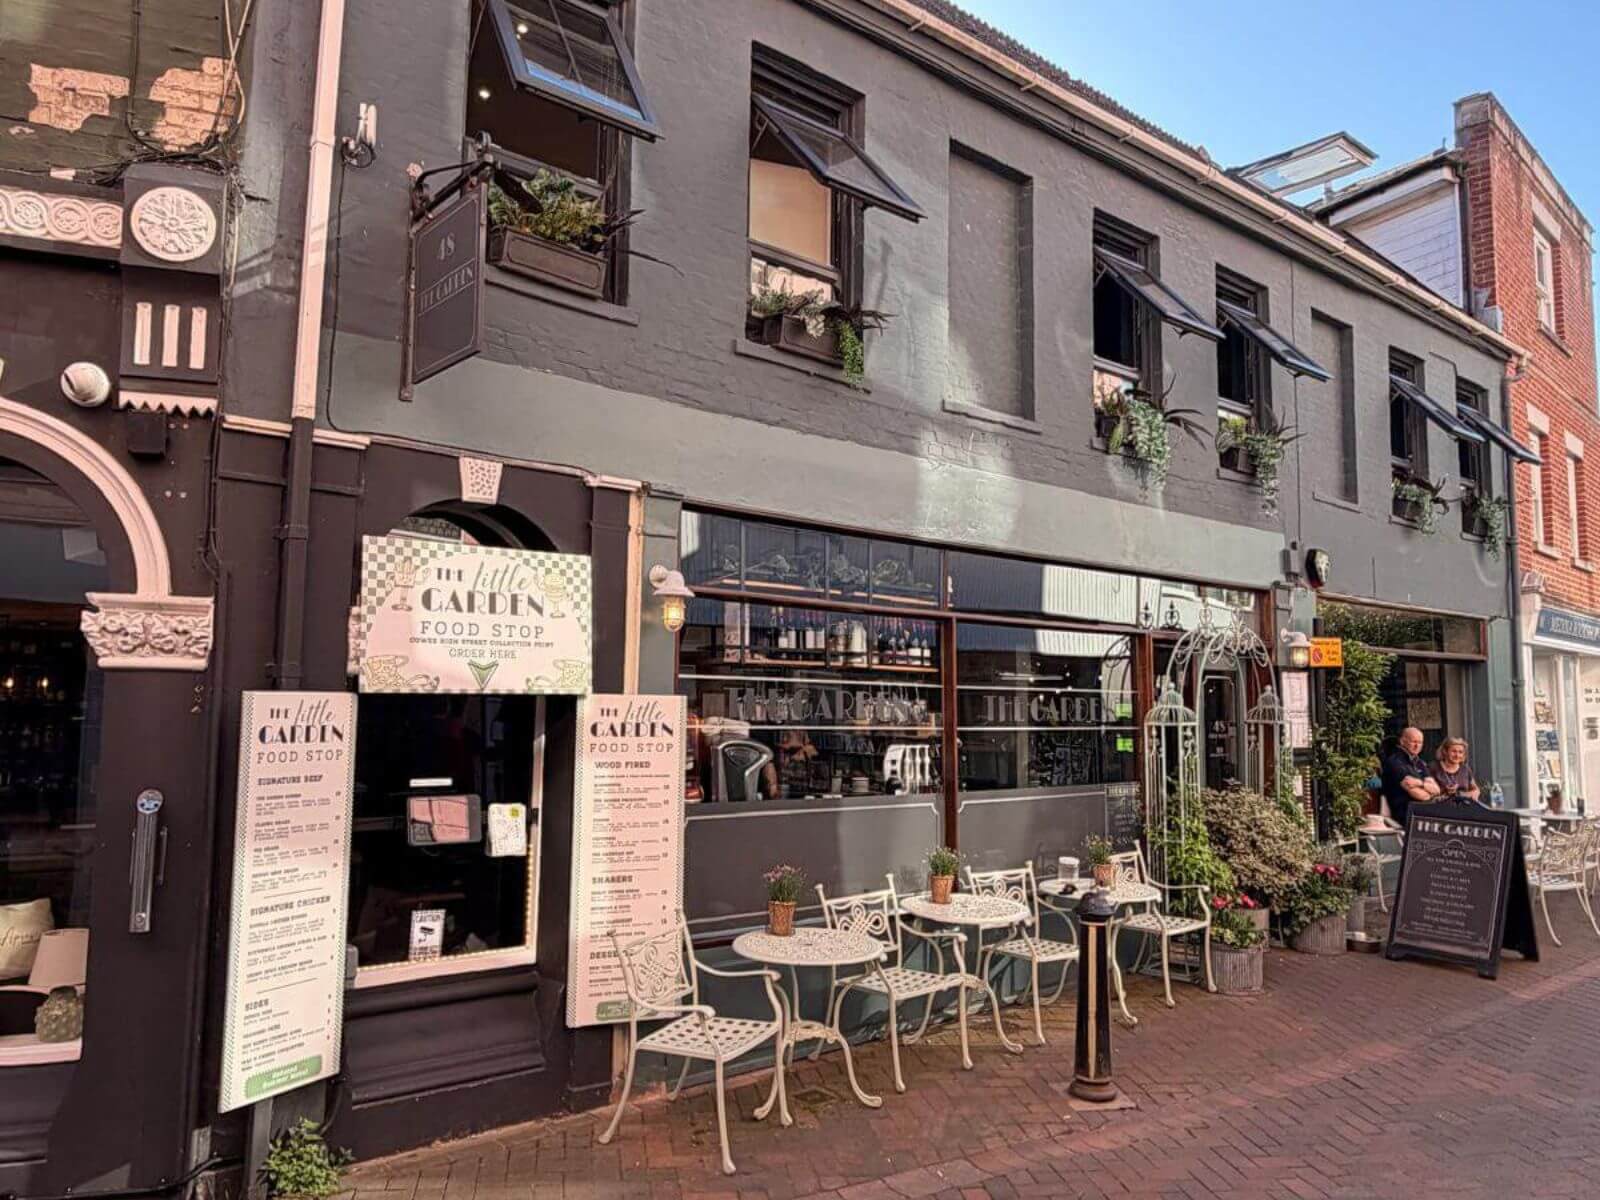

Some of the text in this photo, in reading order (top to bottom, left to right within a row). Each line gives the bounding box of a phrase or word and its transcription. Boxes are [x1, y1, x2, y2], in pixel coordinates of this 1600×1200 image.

[436, 561, 529, 592] THE little
[421, 587, 545, 617] GARDEN
[420, 621, 545, 639] FOOD STOP
[461, 638, 487, 646] STREET
[489, 639, 531, 648] COLLECTION
[449, 648, 517, 659] ORDER HERE
[270, 699, 335, 727] THE little
[624, 700, 665, 722] little
[984, 695, 1027, 722] THE
[258, 724, 344, 744] GARDEN
[590, 721, 674, 738] GARDEN
[257, 749, 343, 764] FOOD STOP
[590, 743, 674, 753] FOOD STOP
[594, 761, 652, 769] WOOD FIRED
[258, 775, 301, 786] SIGNATURE
[1417, 821, 1502, 840] THE GARDEN
[592, 875, 633, 885] SHARERS
